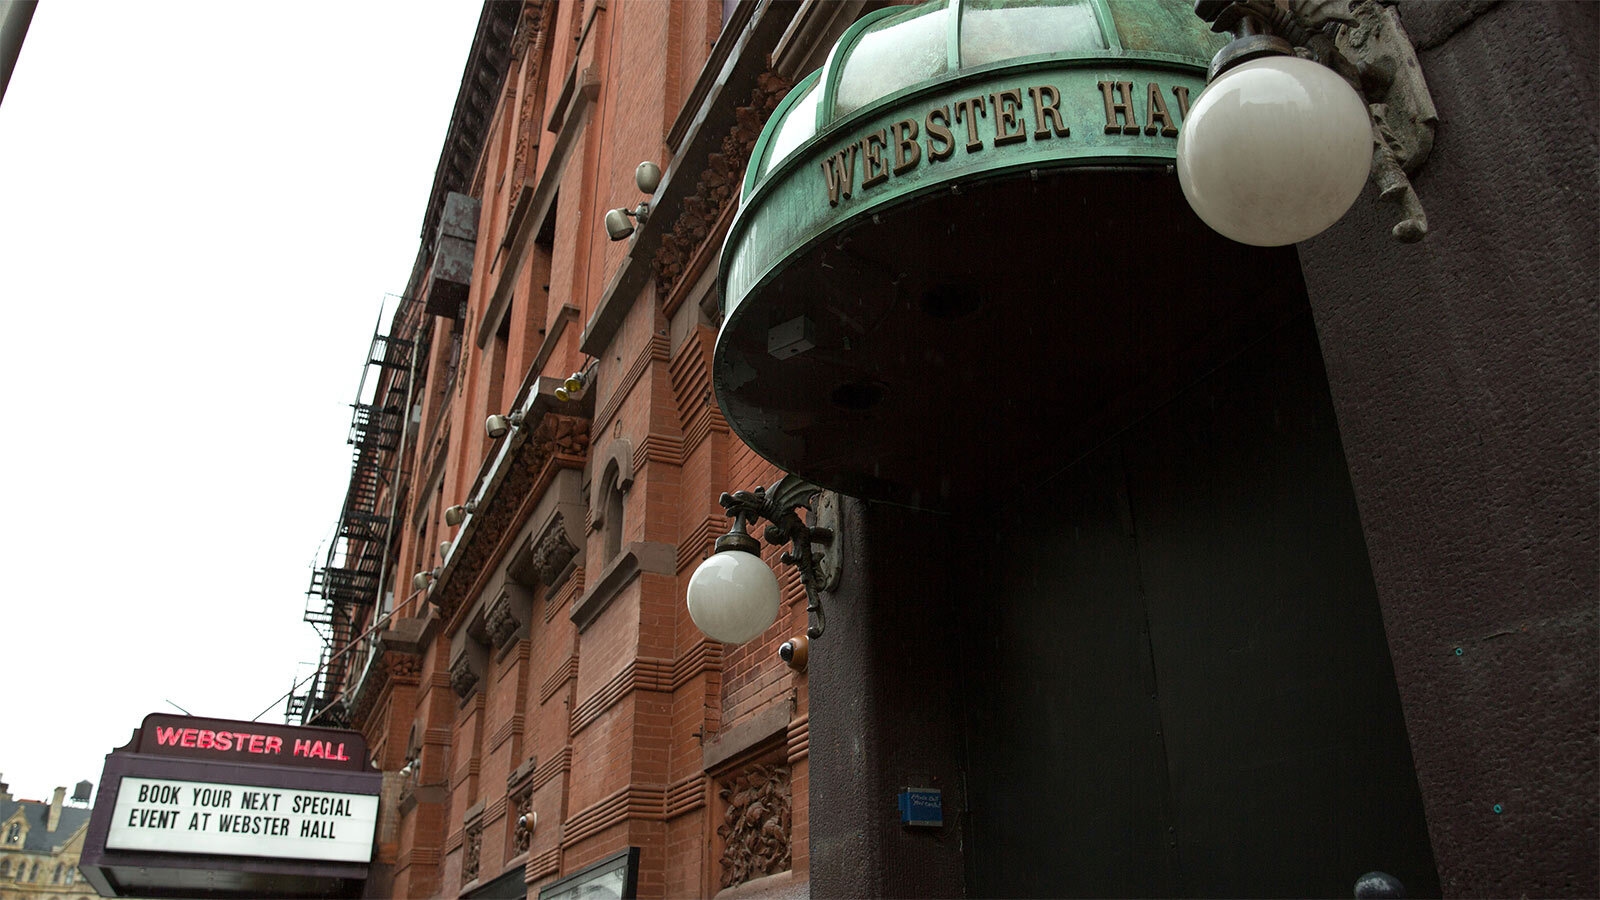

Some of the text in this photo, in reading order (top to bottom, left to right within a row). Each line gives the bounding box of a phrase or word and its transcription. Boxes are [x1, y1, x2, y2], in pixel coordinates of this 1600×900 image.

[821, 84, 1070, 208] WEBSTER
[156, 726, 350, 762] WEBSTER HALL
[138, 784, 352, 817] BOOK YOUR NEXT SPECIAL
[128, 808, 336, 840] EVENT AT WEBSTER HALL
